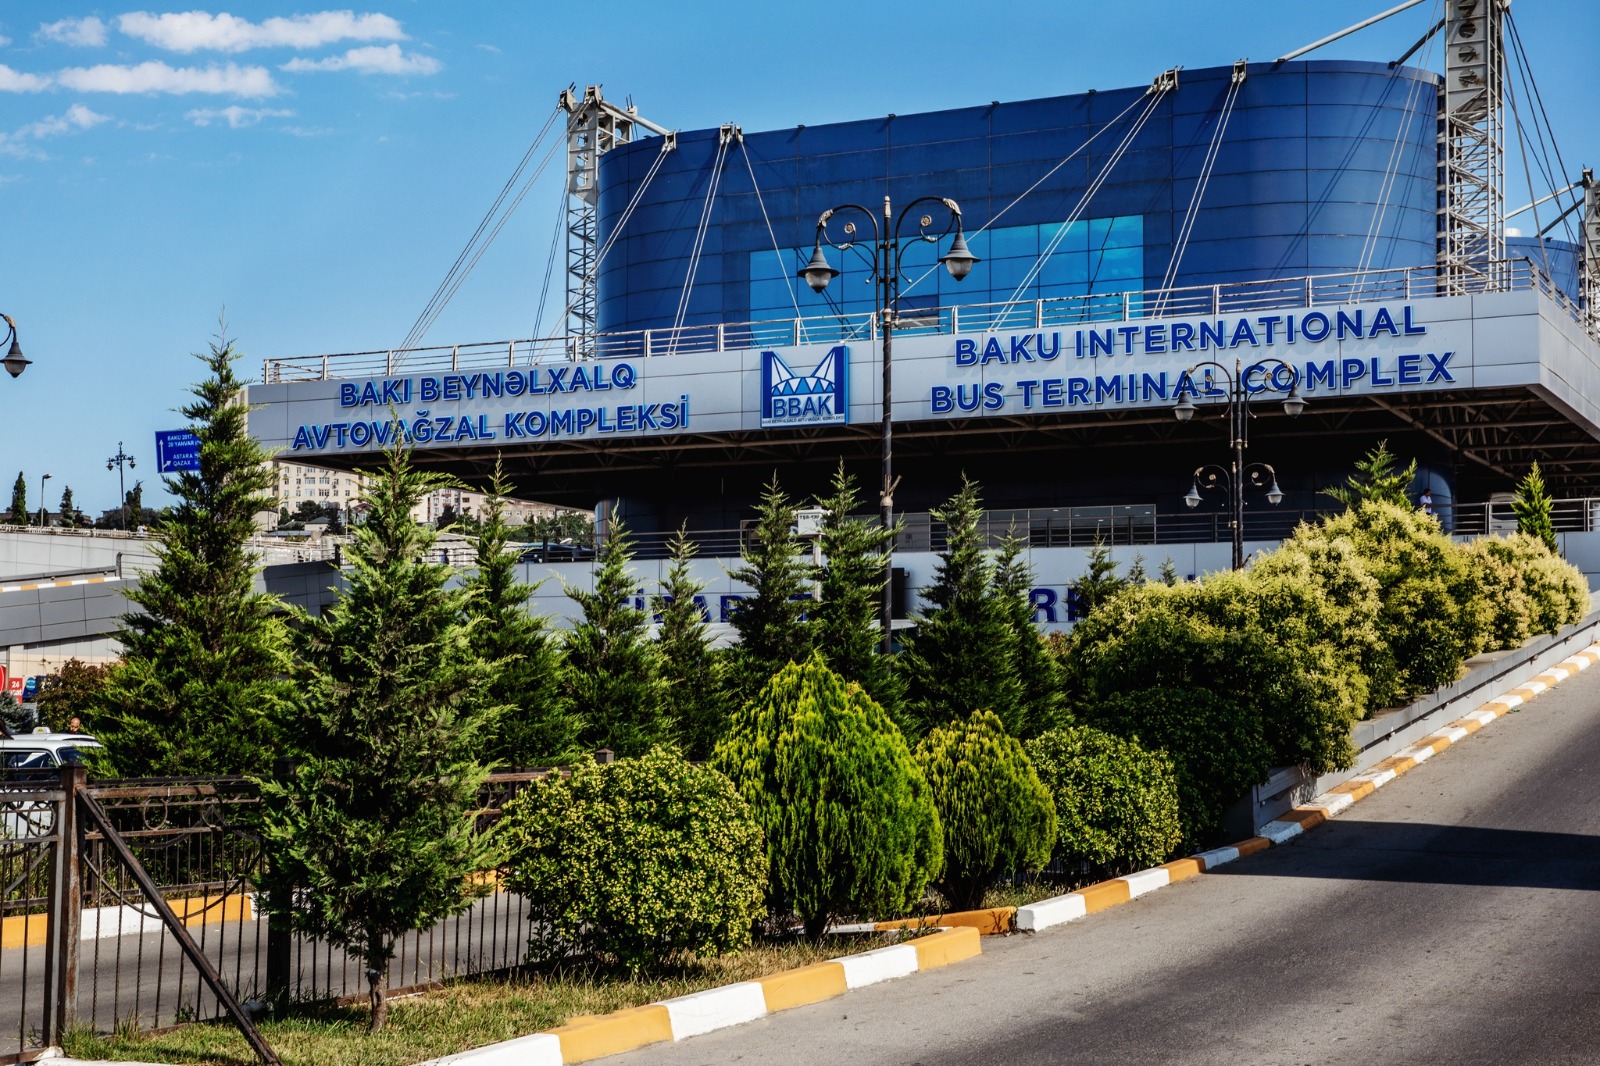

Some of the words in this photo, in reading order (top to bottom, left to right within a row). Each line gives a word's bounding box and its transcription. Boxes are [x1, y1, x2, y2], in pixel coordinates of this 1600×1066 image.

[955, 332, 1061, 367] BAKU
[1075, 305, 1428, 359] INTERNATIONAL
[339, 378, 412, 408] BAKI
[420, 363, 636, 402] BEYNƏLXALQ
[773, 395, 833, 418] BBAK
[930, 382, 1005, 414] BUS
[1016, 369, 1226, 409] TERMINAL
[1241, 350, 1456, 394] COMPLEX
[292, 409, 496, 450] AVTOVAĞZAL
[504, 394, 689, 438] KOMPLEKSİ
[11, 681, 20, 689] 24
